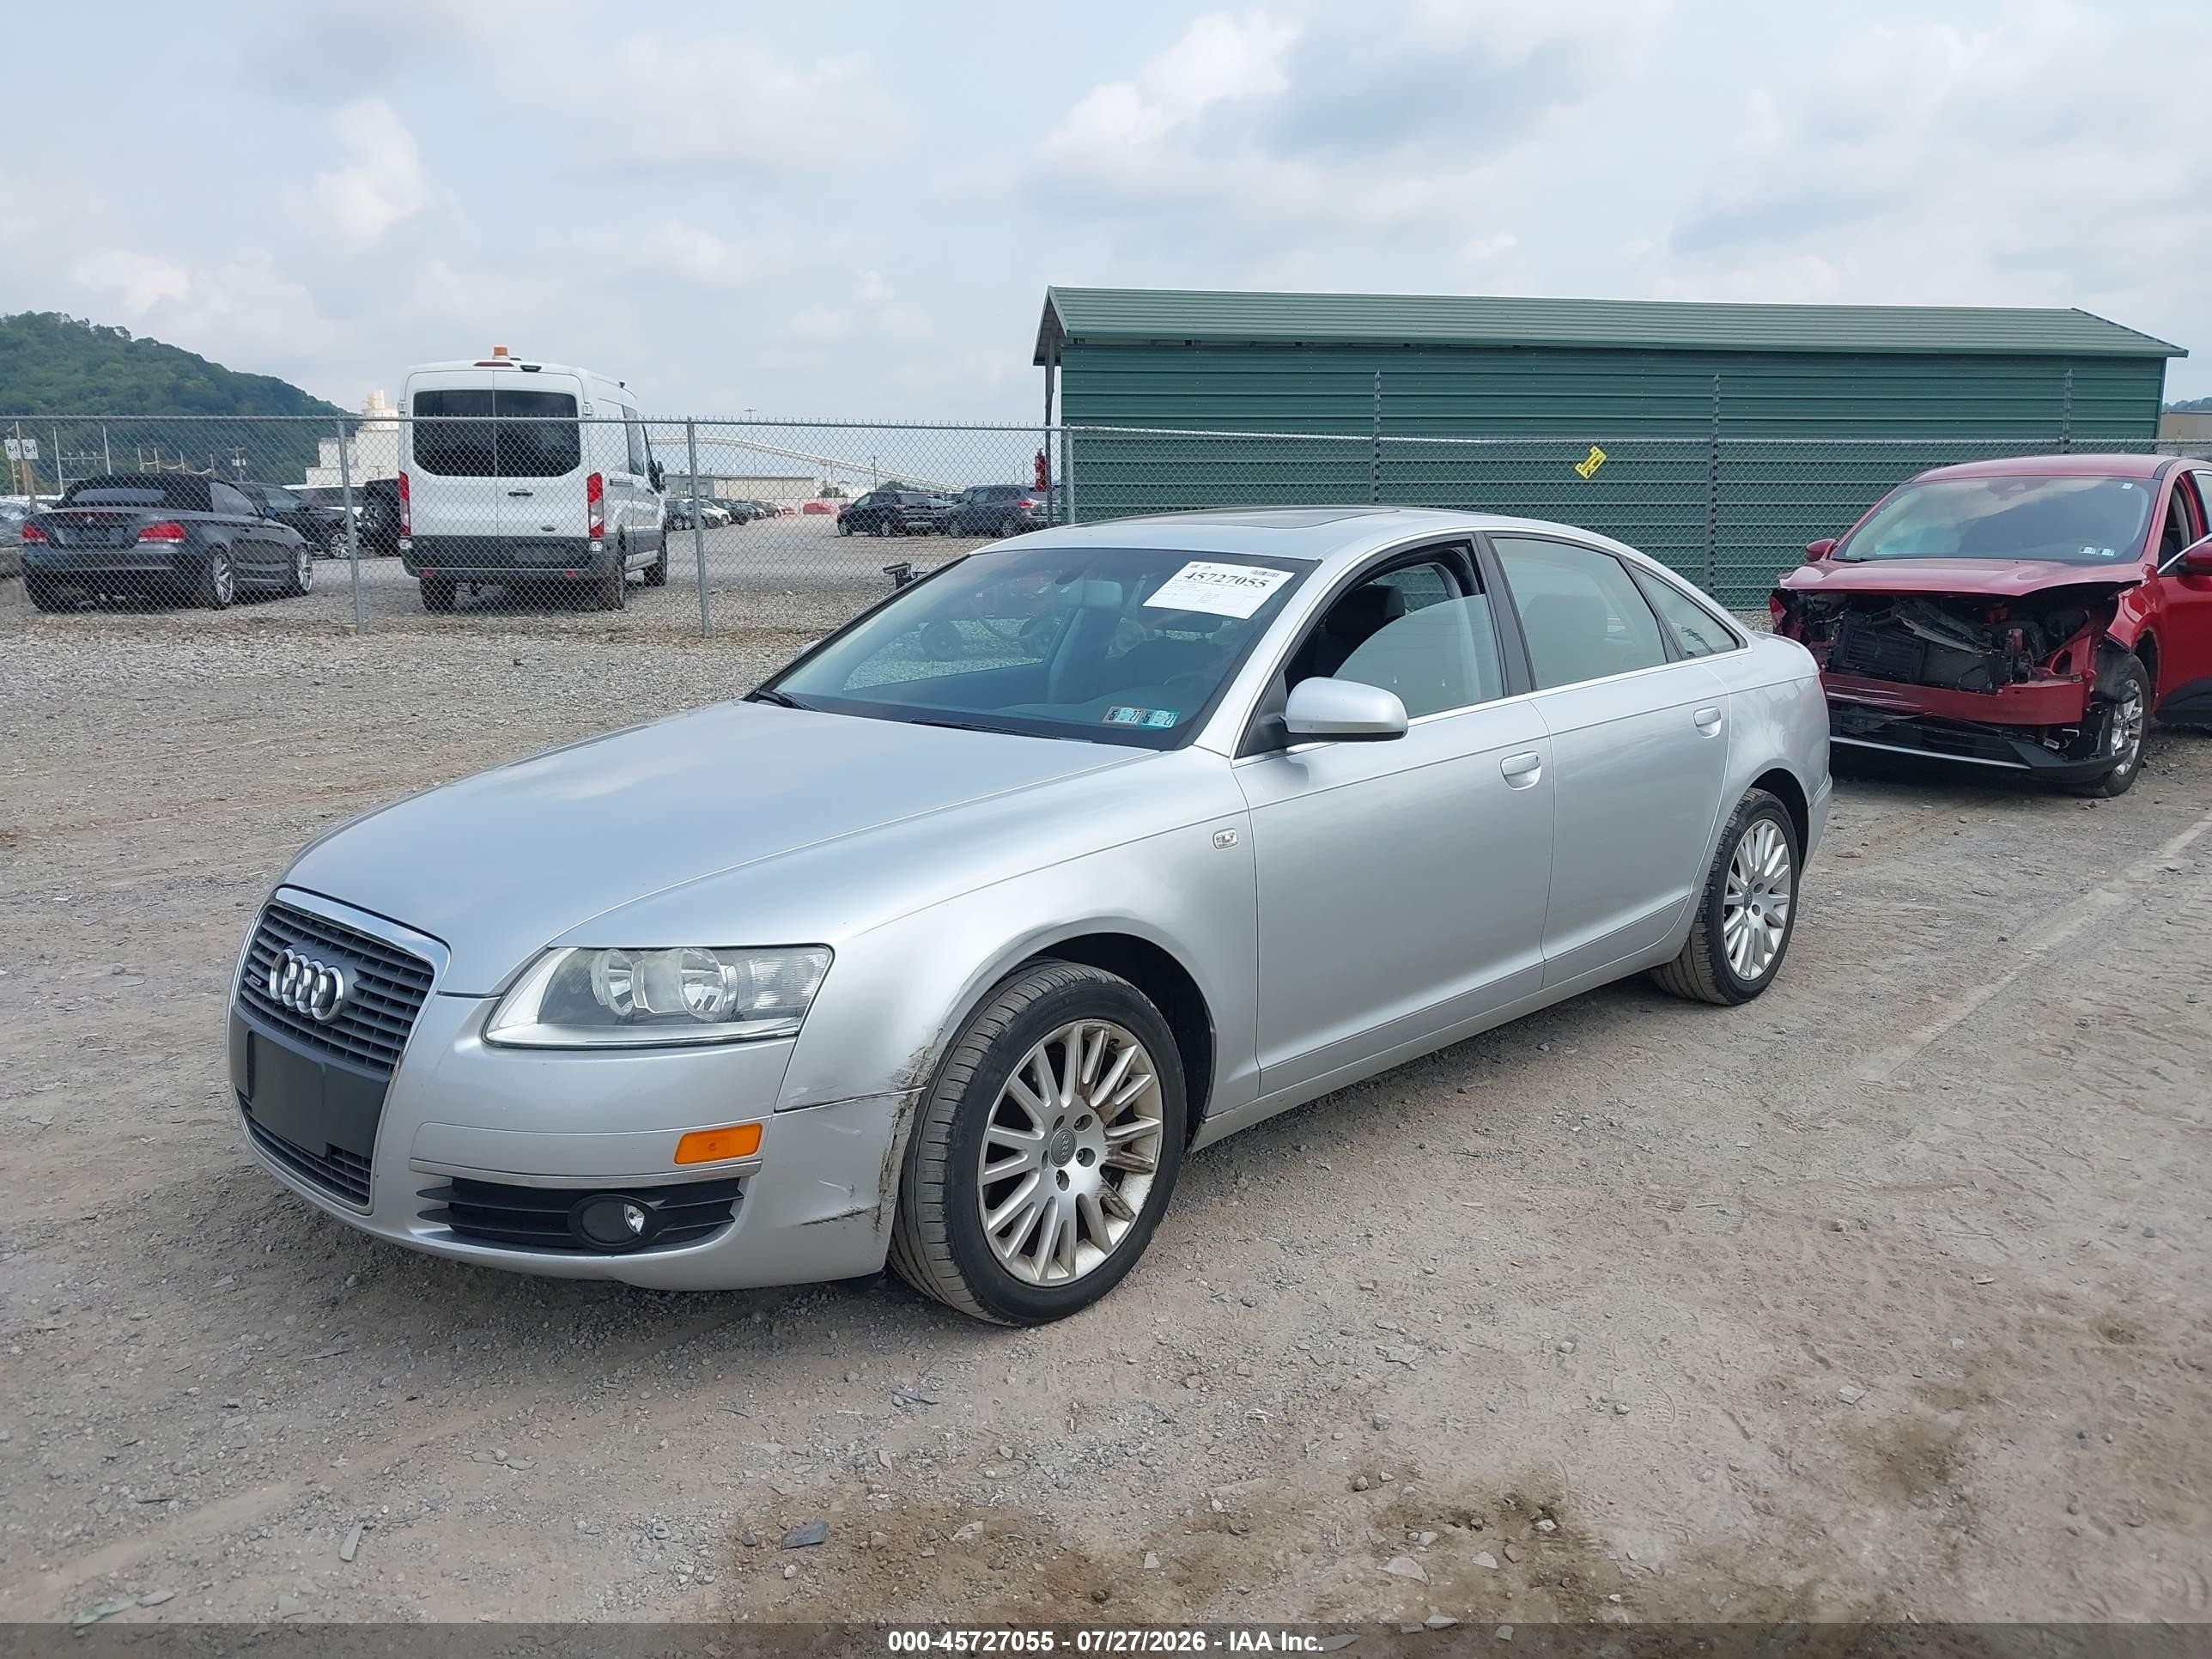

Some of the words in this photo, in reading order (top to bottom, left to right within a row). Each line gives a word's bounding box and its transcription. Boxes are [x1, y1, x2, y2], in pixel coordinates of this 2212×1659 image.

[1184, 572, 1270, 589] 45727055
[1129, 710, 1141, 722] 27
[1164, 714, 1176, 726] 27
